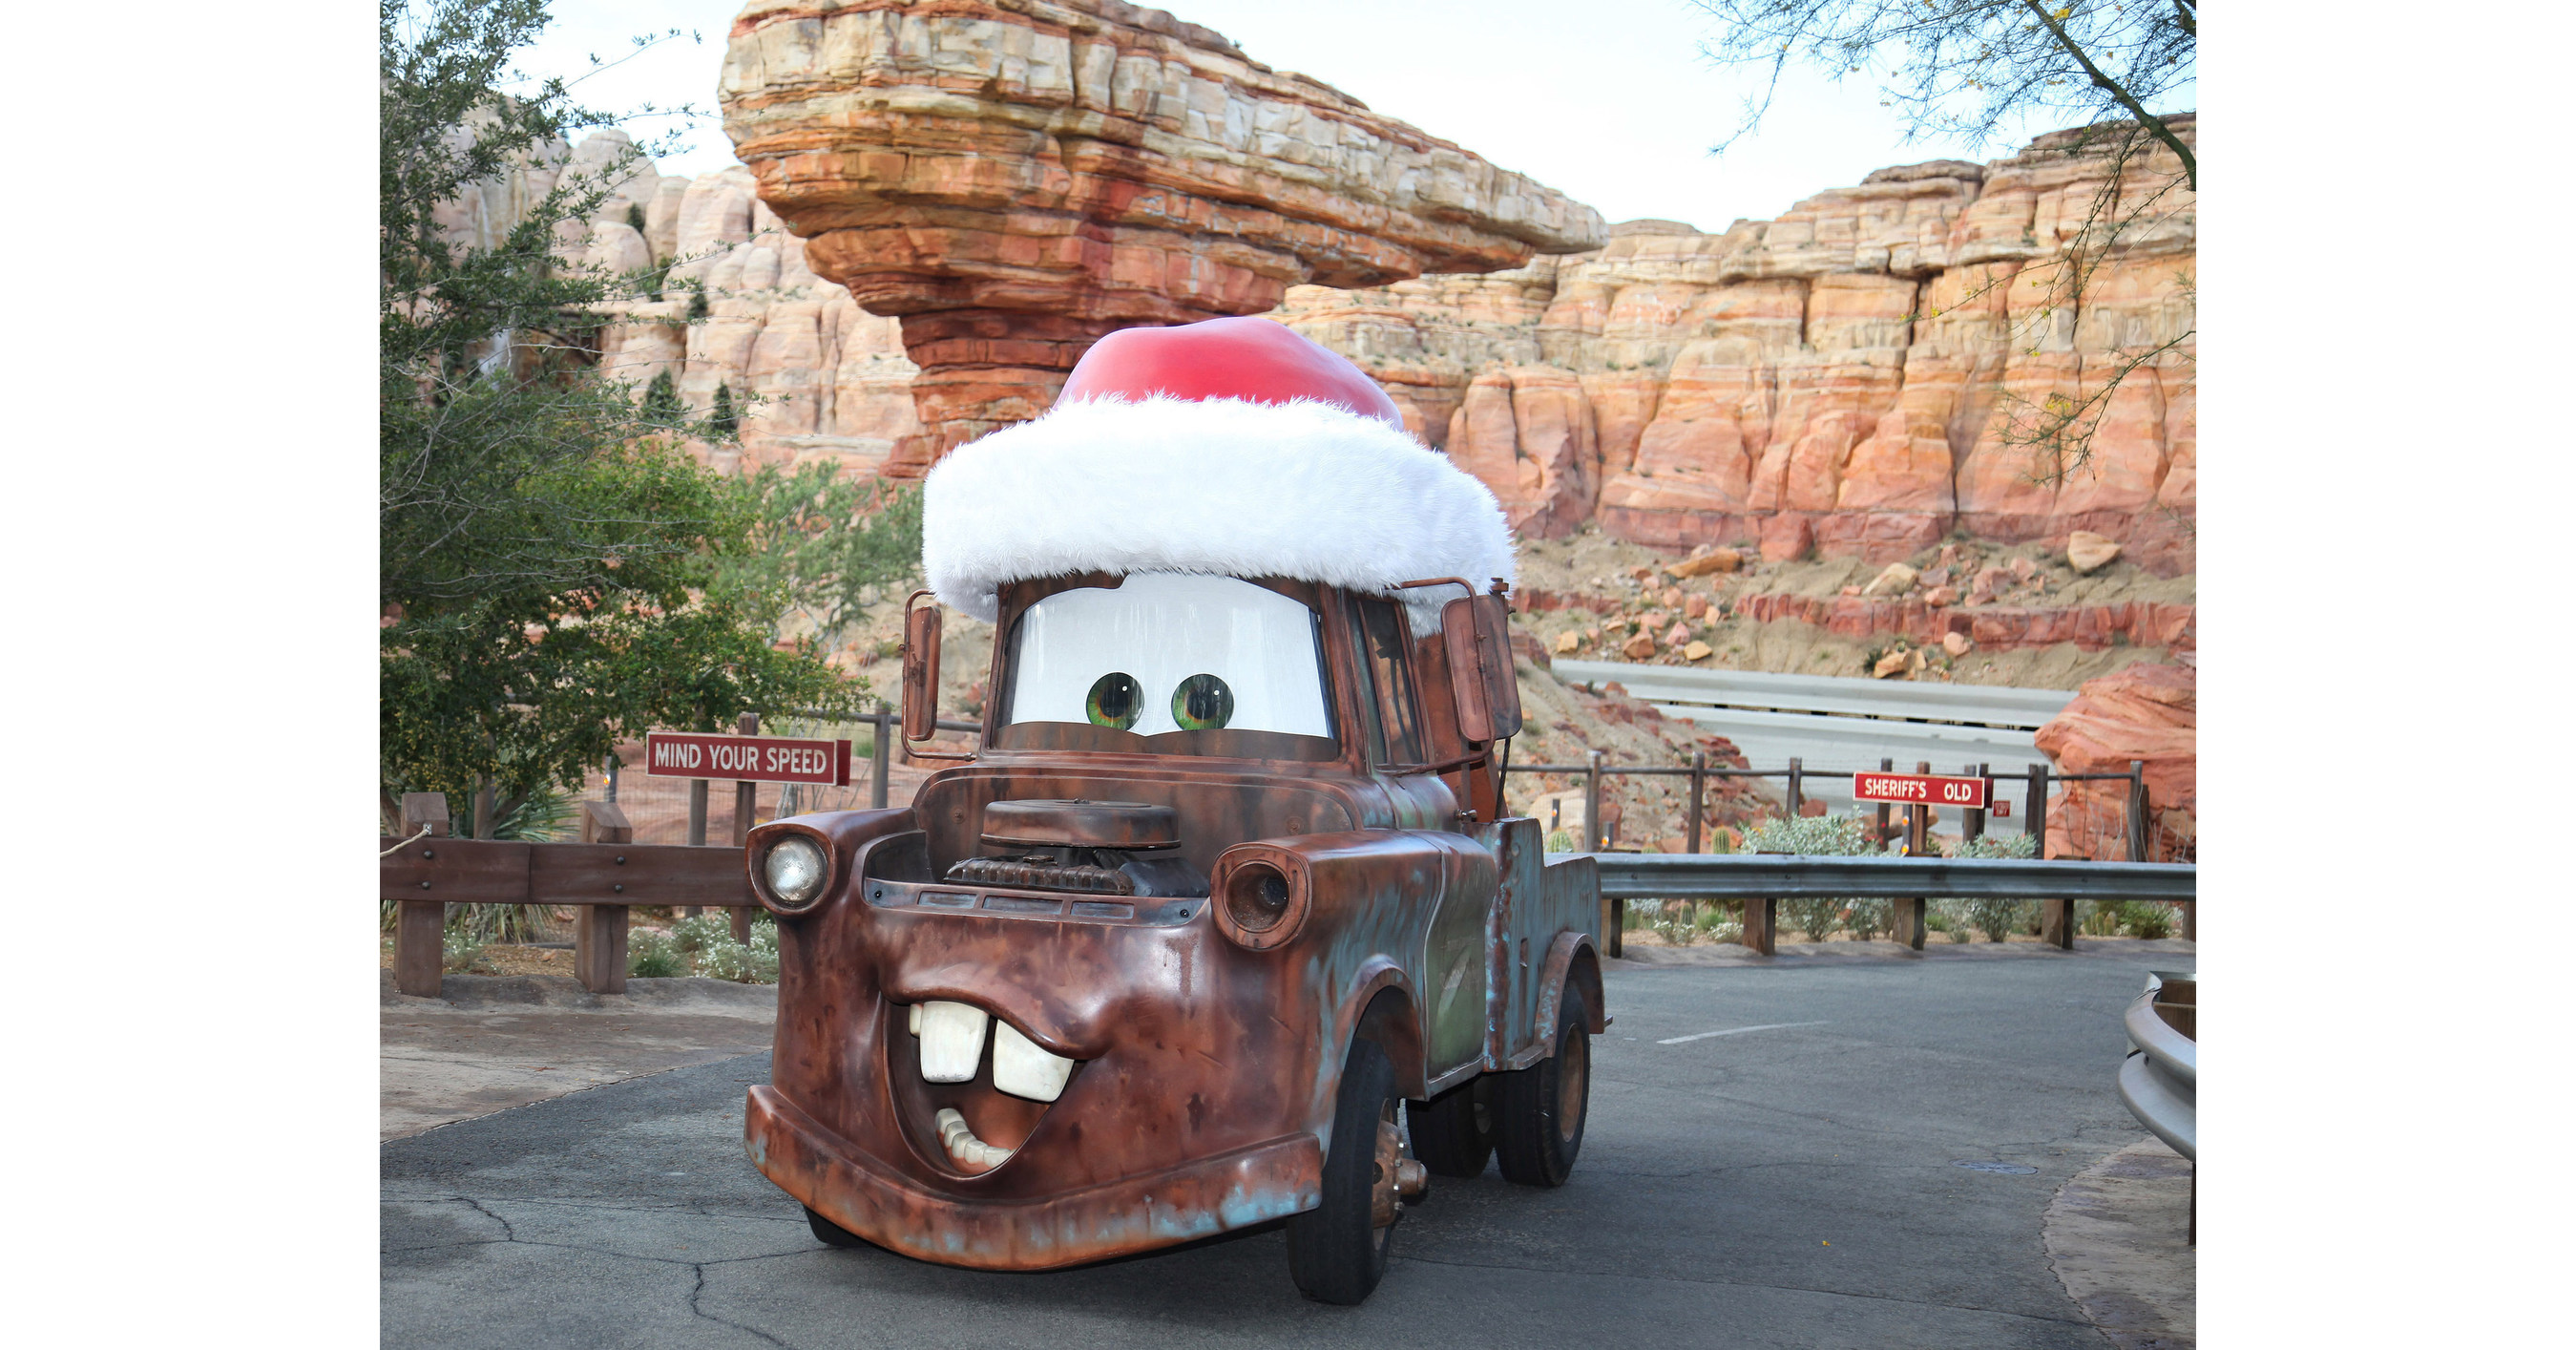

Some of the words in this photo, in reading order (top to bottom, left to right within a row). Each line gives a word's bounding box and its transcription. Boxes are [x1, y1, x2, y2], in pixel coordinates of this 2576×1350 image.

[655, 743, 702, 769] MIND
[708, 745, 759, 771] YOUR
[765, 748, 827, 774] SPEED
[1865, 777, 1926, 799] SHERIFF'S
[1943, 783, 1972, 802] OLD
